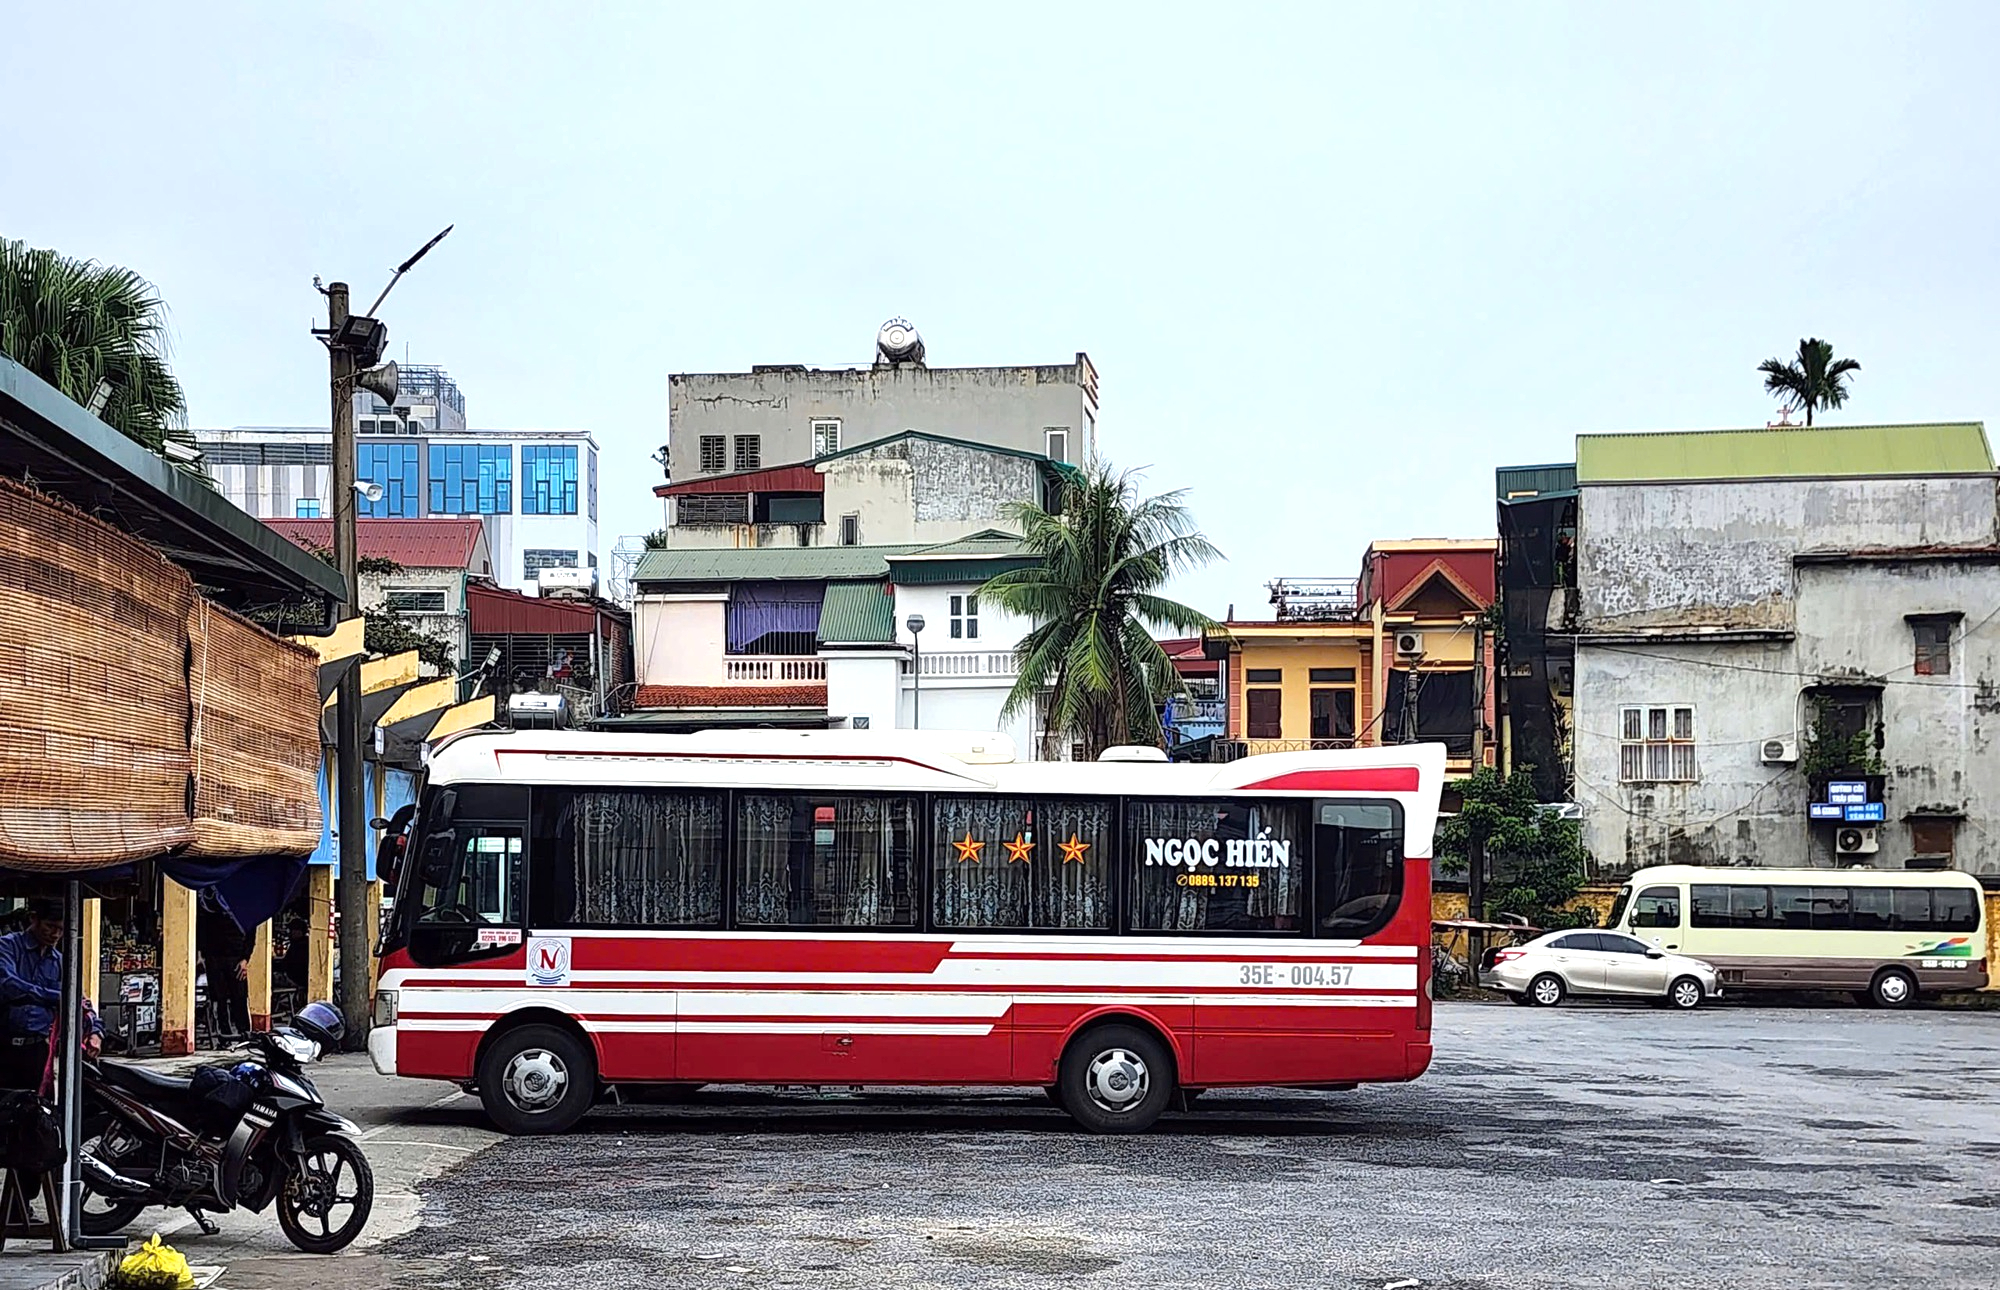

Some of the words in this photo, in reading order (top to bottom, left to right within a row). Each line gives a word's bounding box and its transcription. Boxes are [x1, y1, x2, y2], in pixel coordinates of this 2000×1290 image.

[1145, 838, 1219, 872] NGỌC
[1225, 826, 1290, 868] HIẾN
[540, 947, 560, 970] N
[1240, 965, 1273, 985] 35E
[1291, 966, 1353, 985] 004.57
[252, 1102, 278, 1118] YAMAHA
